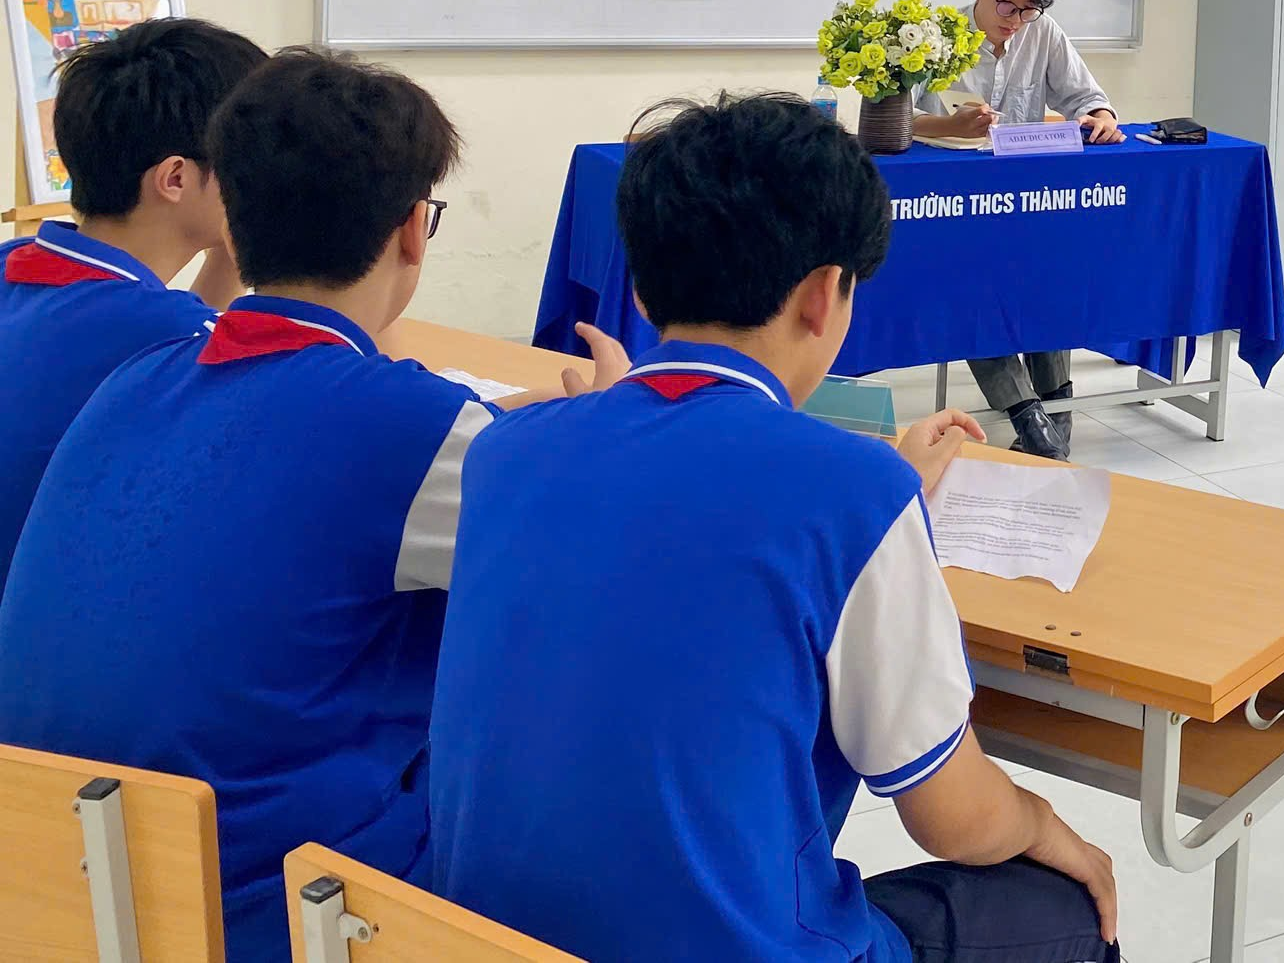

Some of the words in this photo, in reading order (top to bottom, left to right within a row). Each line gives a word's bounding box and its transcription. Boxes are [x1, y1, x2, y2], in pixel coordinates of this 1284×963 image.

[1008, 132, 1067, 144] ADJUDICATOR
[890, 192, 964, 221] TRƯỜNG
[969, 193, 1015, 216] THCS
[1020, 186, 1077, 212] THÀNH
[1081, 182, 1127, 208] CÔNG
